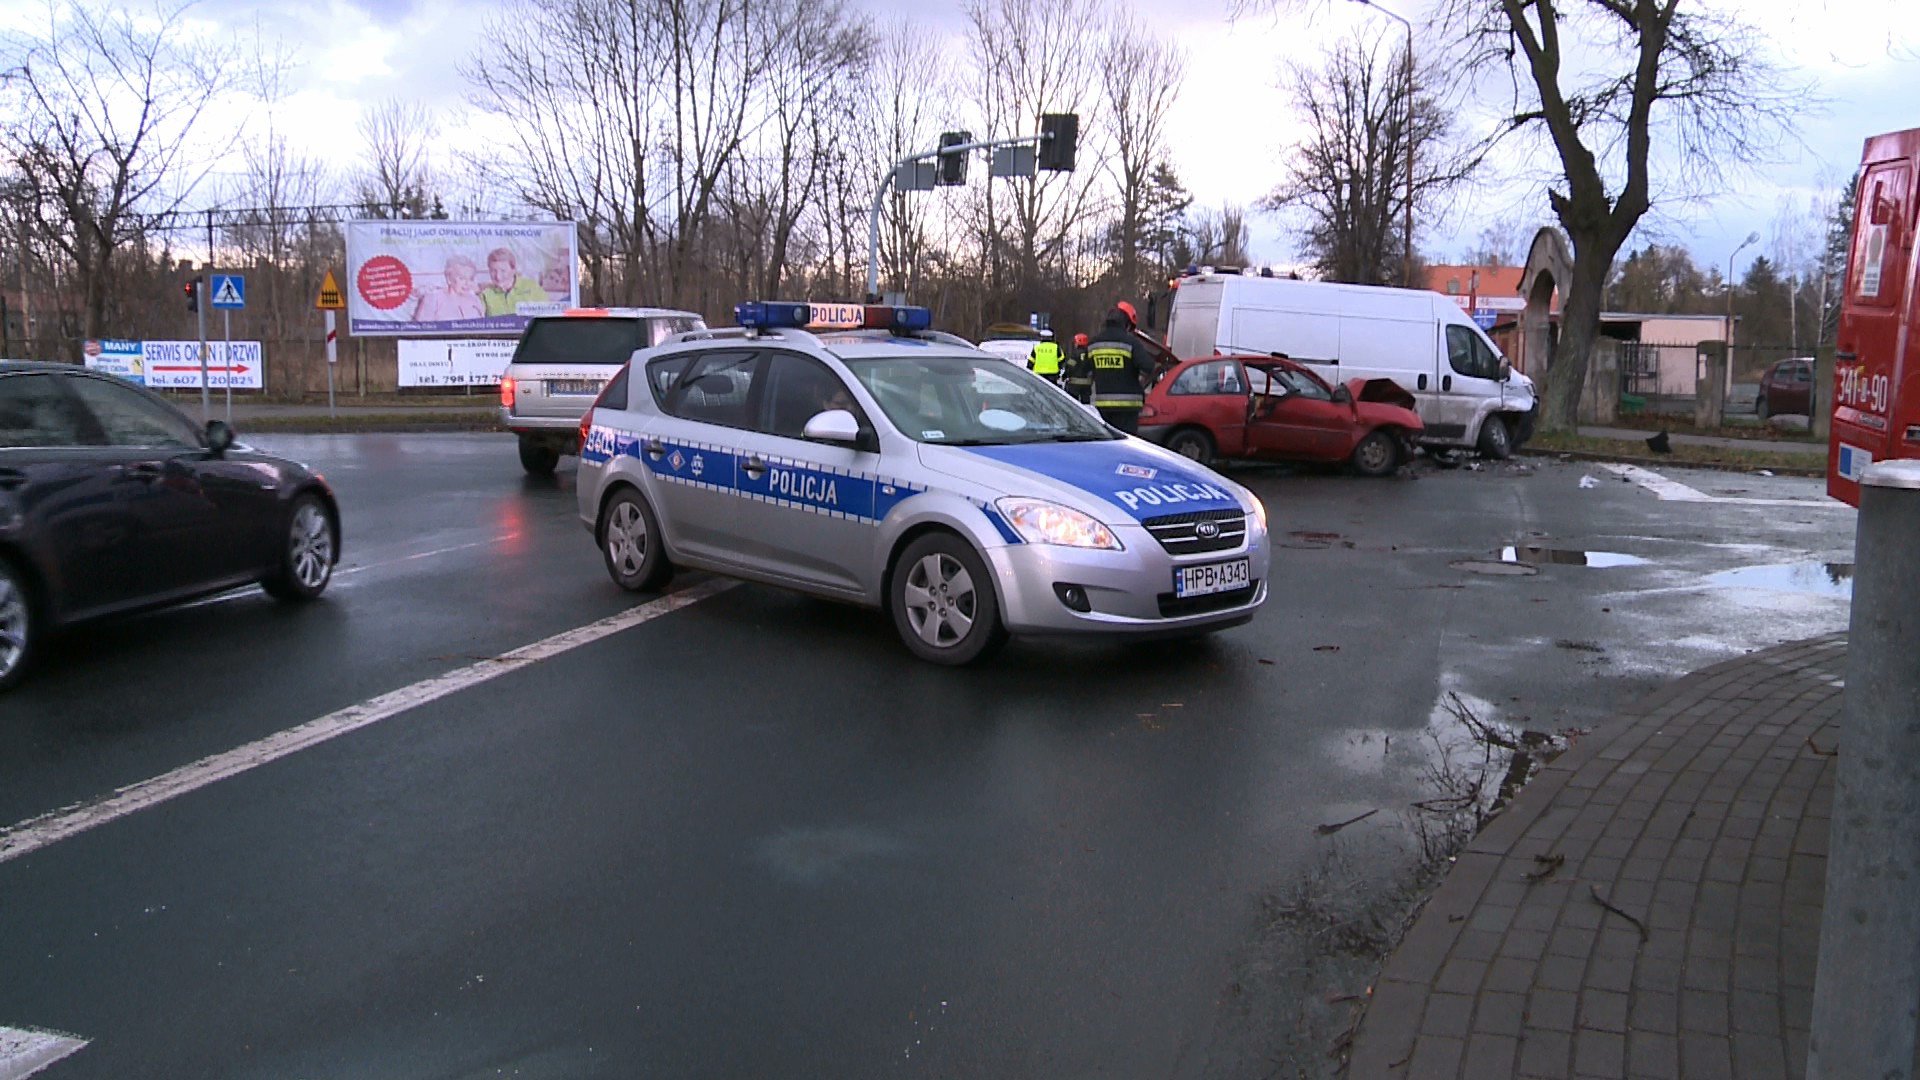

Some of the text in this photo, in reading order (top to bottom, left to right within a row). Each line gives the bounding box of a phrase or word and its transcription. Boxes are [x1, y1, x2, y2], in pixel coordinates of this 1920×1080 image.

[811, 306, 863, 323] POLICJA
[104, 342, 137, 352] MANY
[145, 343, 181, 361] SERWIS
[184, 344, 216, 361] OKN
[152, 376, 169, 384] tel.
[206, 376, 227, 385] 20
[768, 468, 838, 505] POLICJA
[1114, 483, 1231, 510] POLICJA
